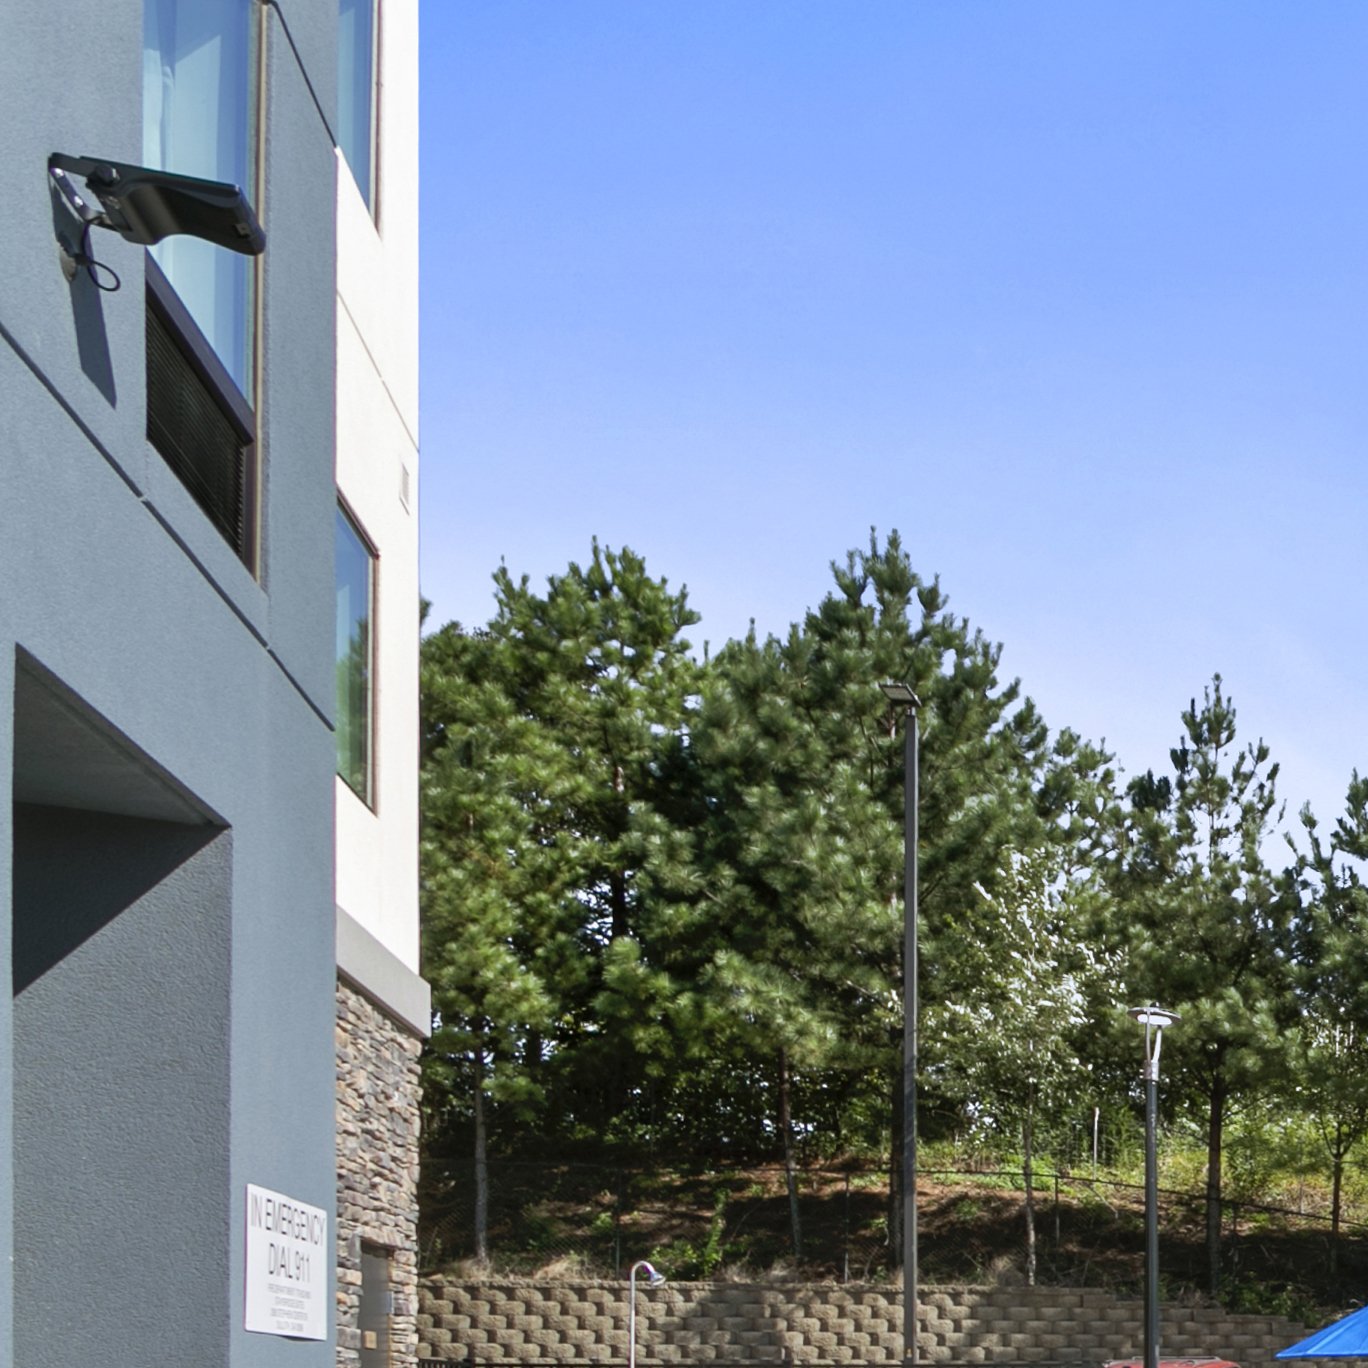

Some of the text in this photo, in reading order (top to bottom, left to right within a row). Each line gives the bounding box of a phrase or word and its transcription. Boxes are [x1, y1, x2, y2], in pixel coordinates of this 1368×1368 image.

[251, 1193, 326, 1247] IN EMERGENCY
[269, 1242, 311, 1283] DIAL 911
